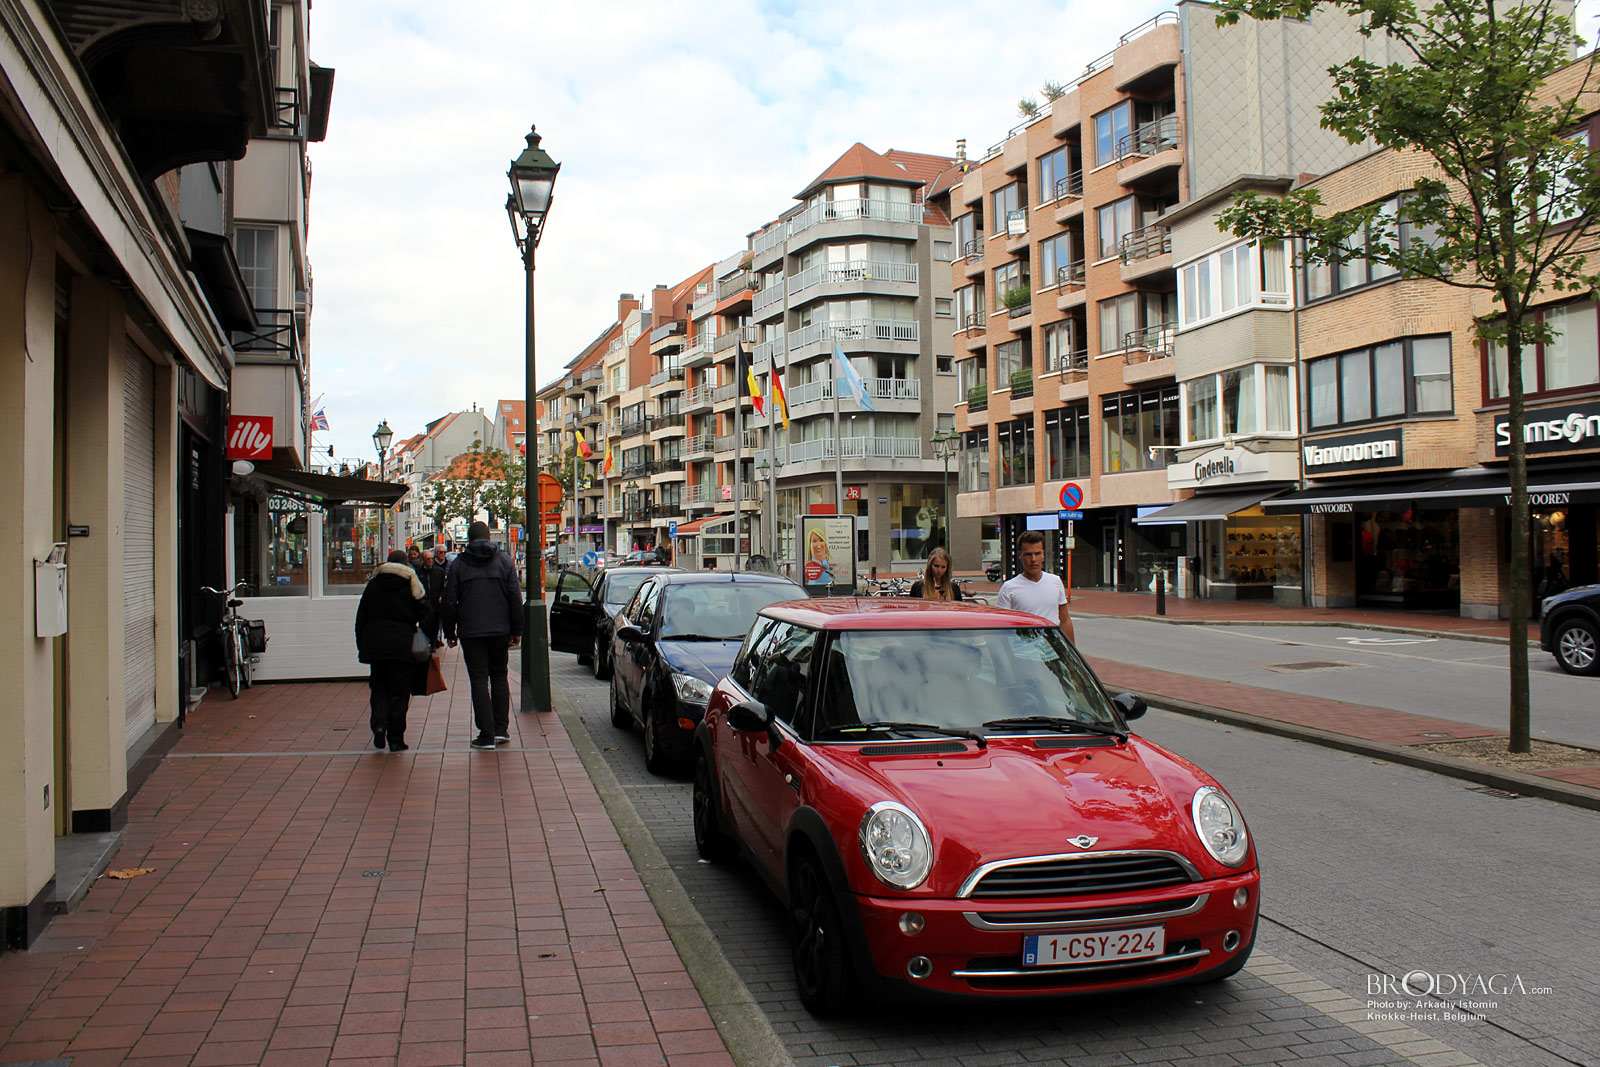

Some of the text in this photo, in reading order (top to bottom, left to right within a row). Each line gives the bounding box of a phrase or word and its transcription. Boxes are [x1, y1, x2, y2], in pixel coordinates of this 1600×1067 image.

[230, 421, 271, 456] illy
[1304, 440, 1399, 466] Vanvooren
[1194, 455, 1234, 482] Cinderella
[268, 499, 280, 510] 03
[1310, 503, 1353, 514] VANVOOREN
[669, 522, 676, 532] P
[1026, 931, 1157, 964] B 1-CSY-224
